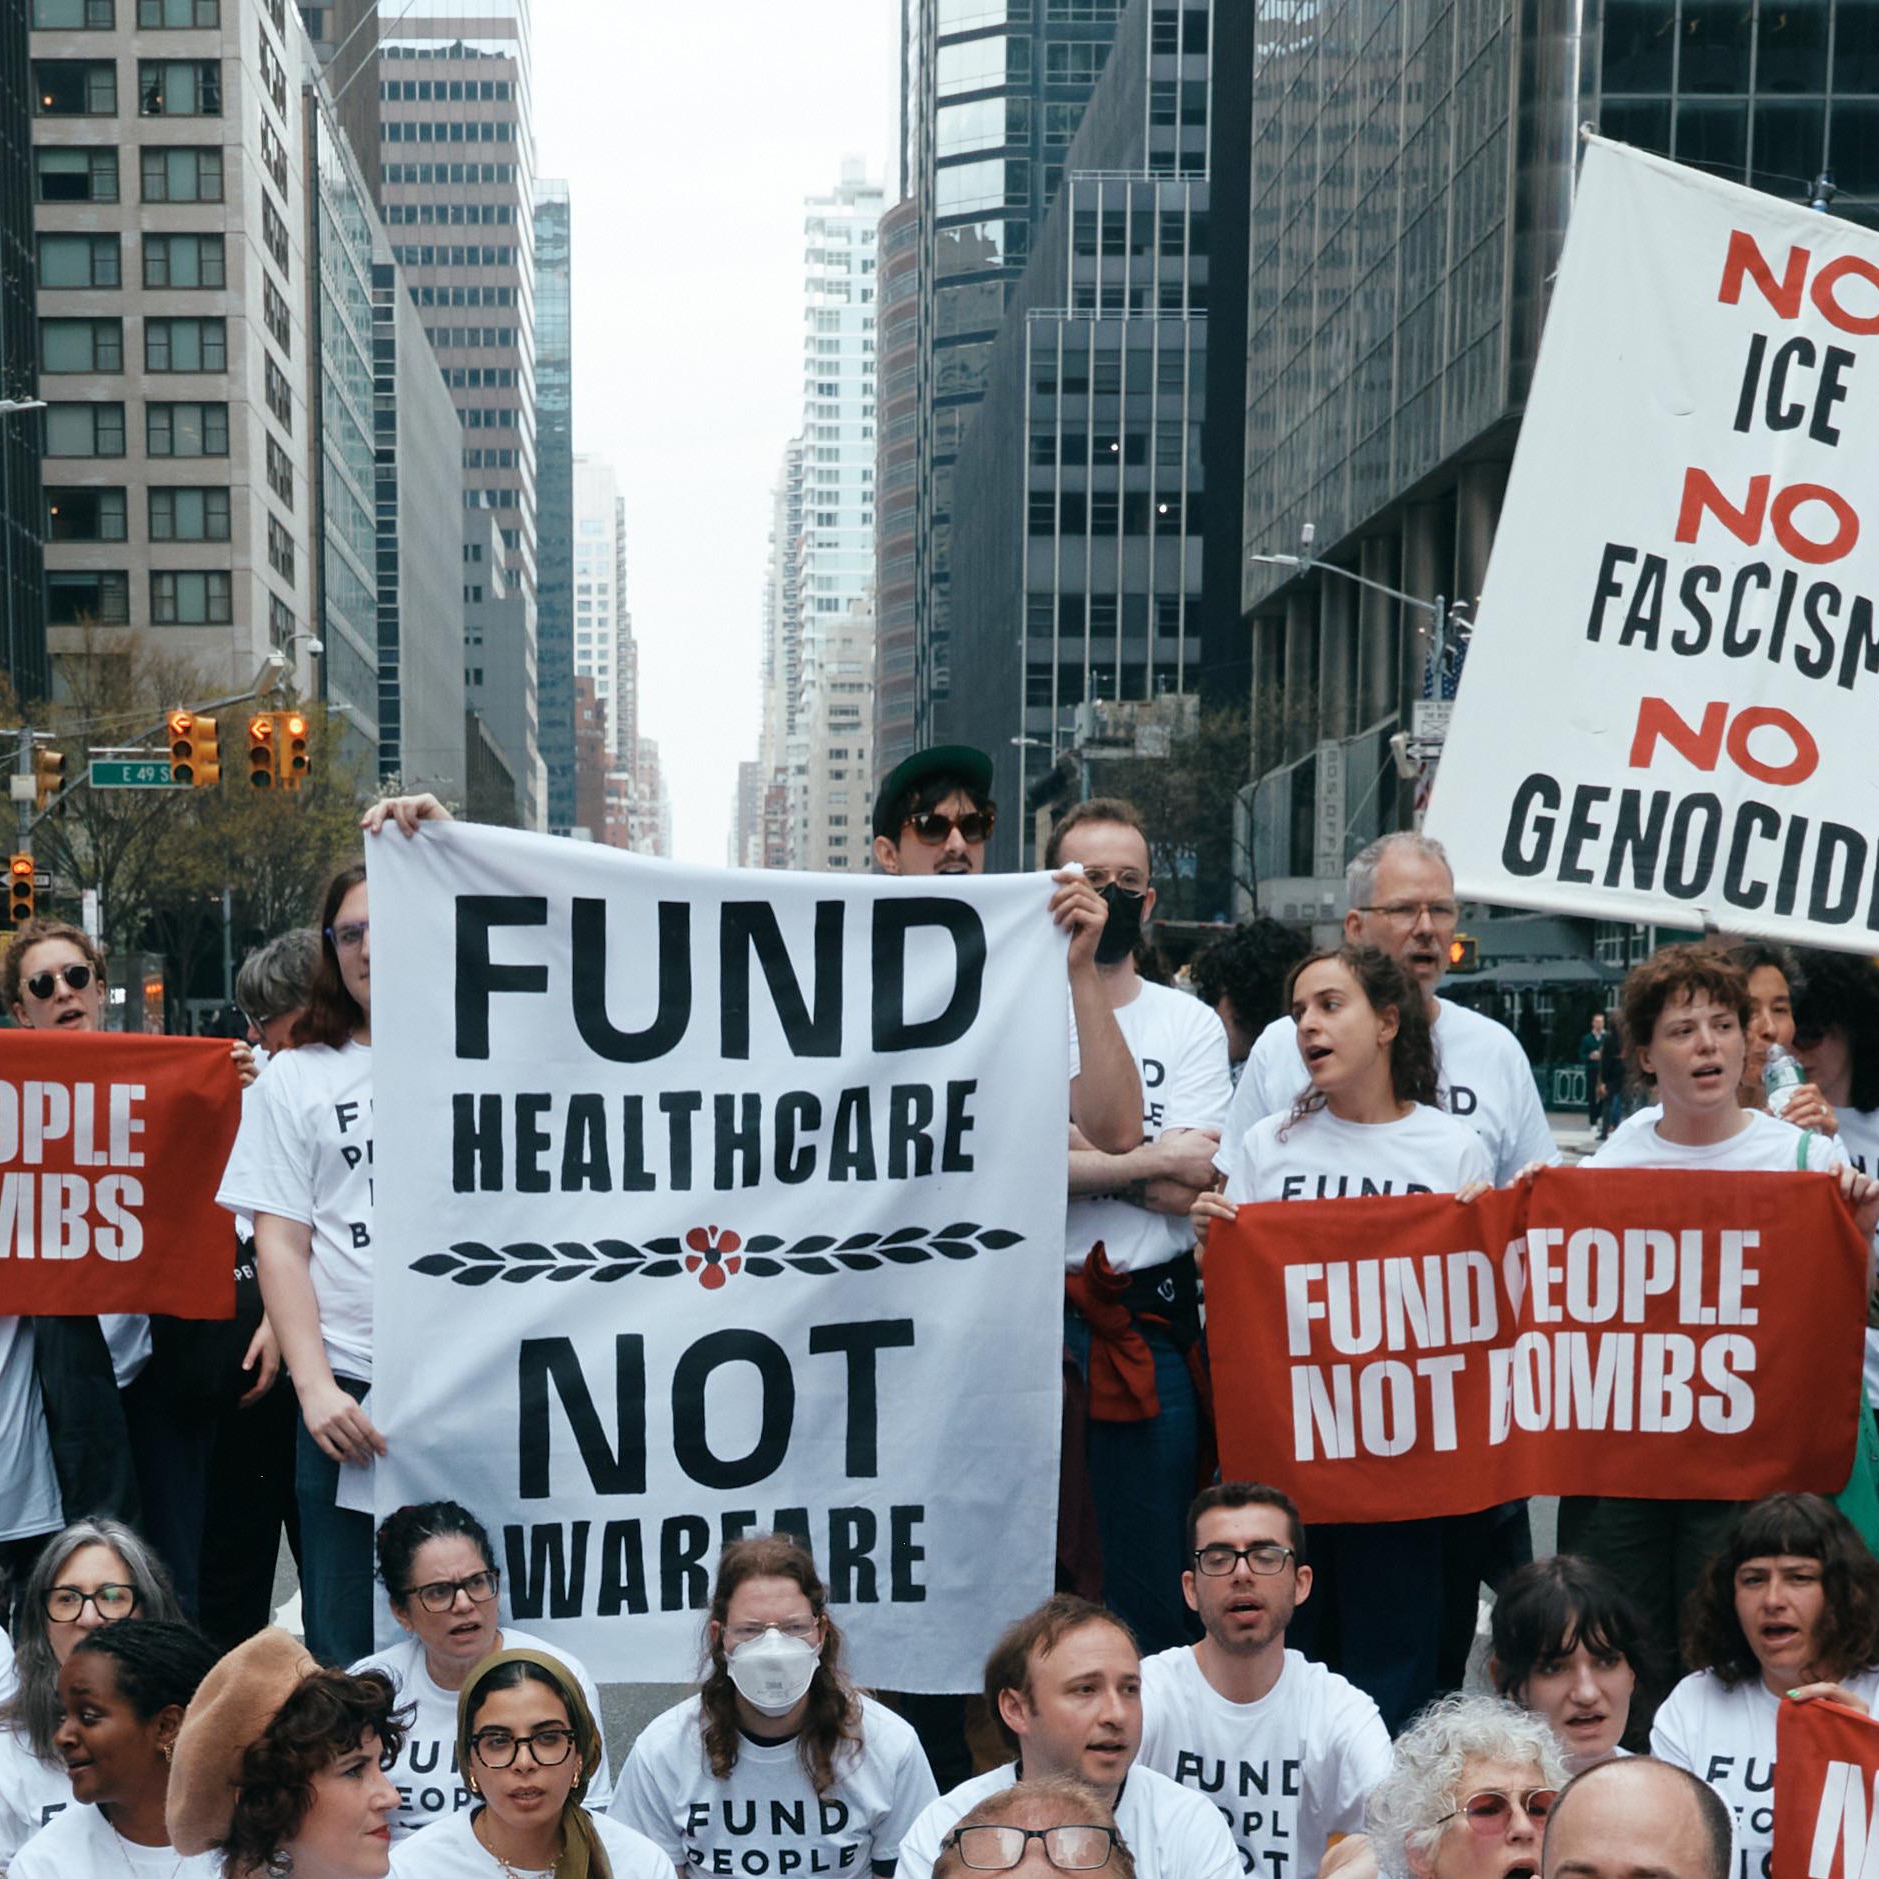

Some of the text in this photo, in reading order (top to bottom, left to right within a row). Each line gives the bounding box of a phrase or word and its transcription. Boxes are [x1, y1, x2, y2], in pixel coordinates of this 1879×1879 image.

[1733, 333, 1856, 447] ICE
[1674, 466, 1860, 565] NO
[123, 767, 130, 781] E
[137, 766, 154, 782] 49
[1629, 696, 1819, 787] NO
[454, 894, 987, 1064] FUND
[452, 1078, 978, 1194] HEALTHCARE
[1283, 1249, 1498, 1354] FUND
[518, 1318, 915, 1500] NOT
[1289, 1345, 1466, 1462] NOT
[684, 1843, 859, 1878] PEOPLE
[686, 1799, 849, 1838] FUND
